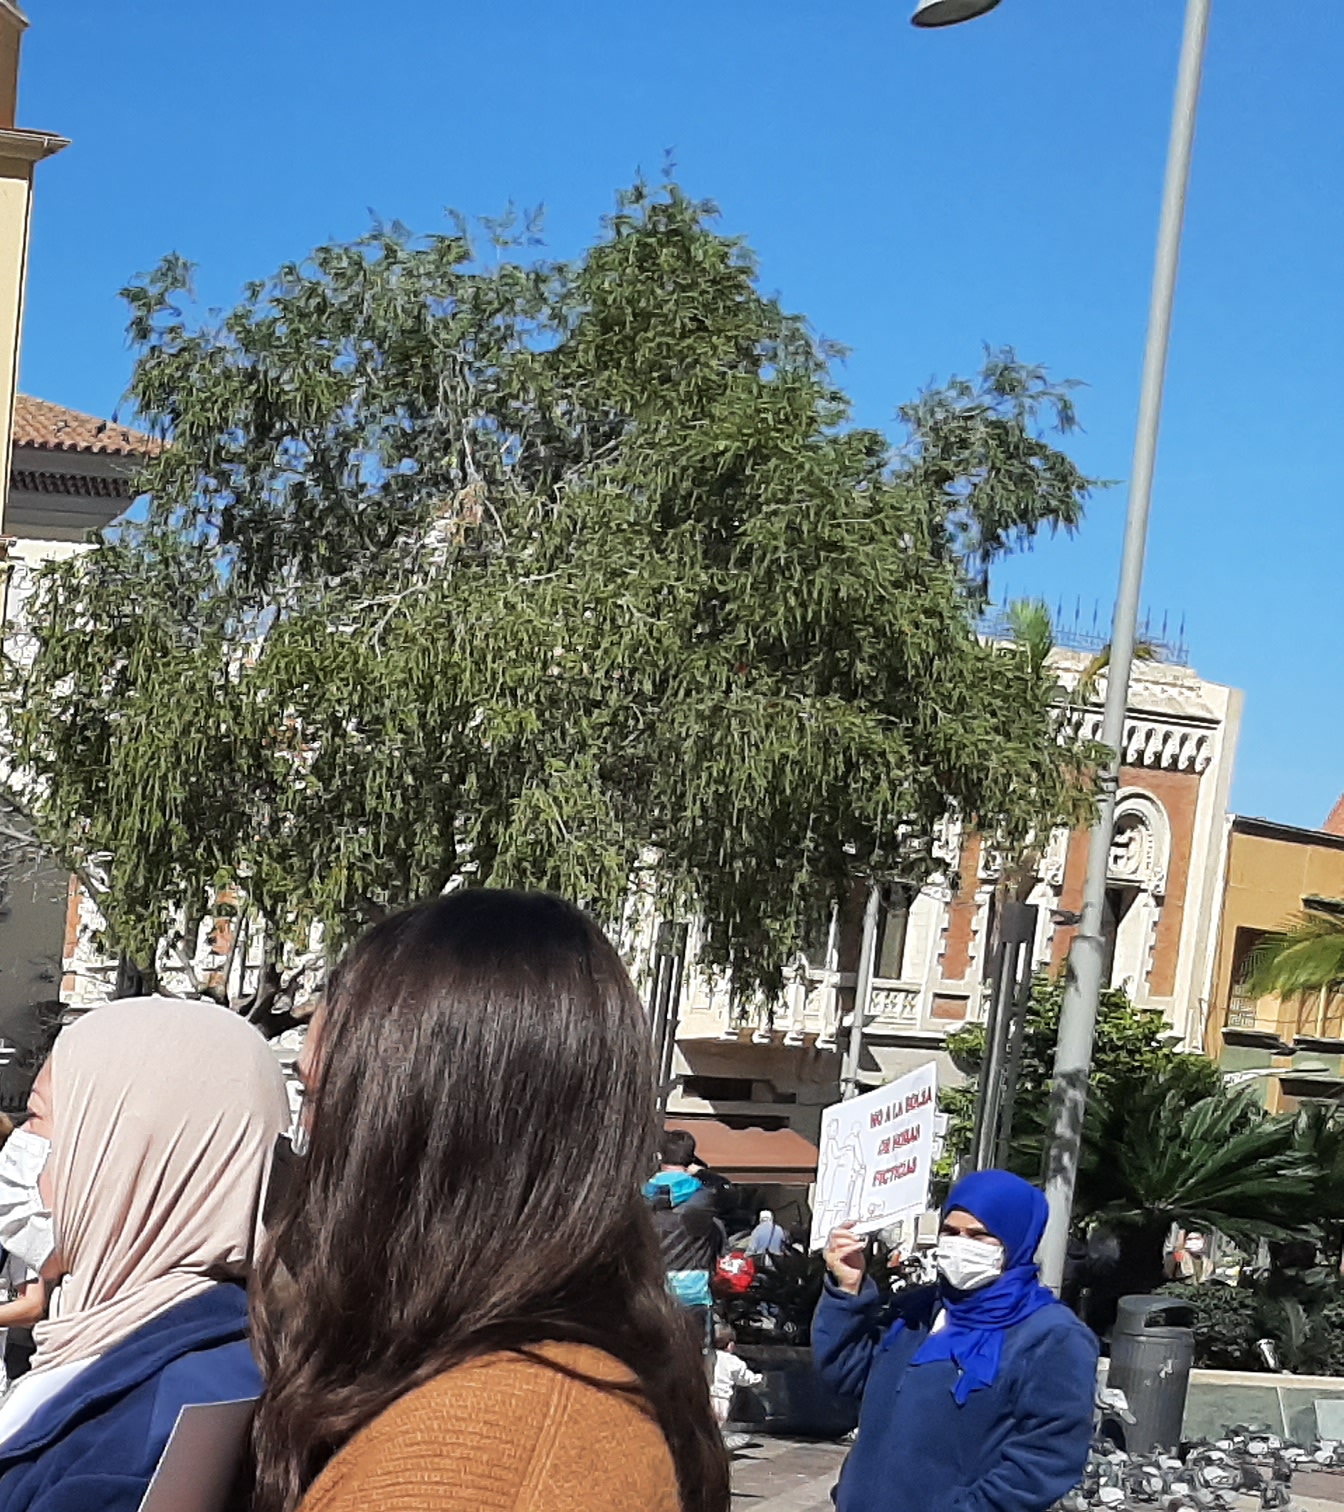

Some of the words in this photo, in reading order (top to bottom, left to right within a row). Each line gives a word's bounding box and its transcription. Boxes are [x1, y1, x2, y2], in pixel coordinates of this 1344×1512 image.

[870, 1108, 883, 1128] NO
[885, 1106, 891, 1123] A
[893, 1101, 904, 1120] LA
